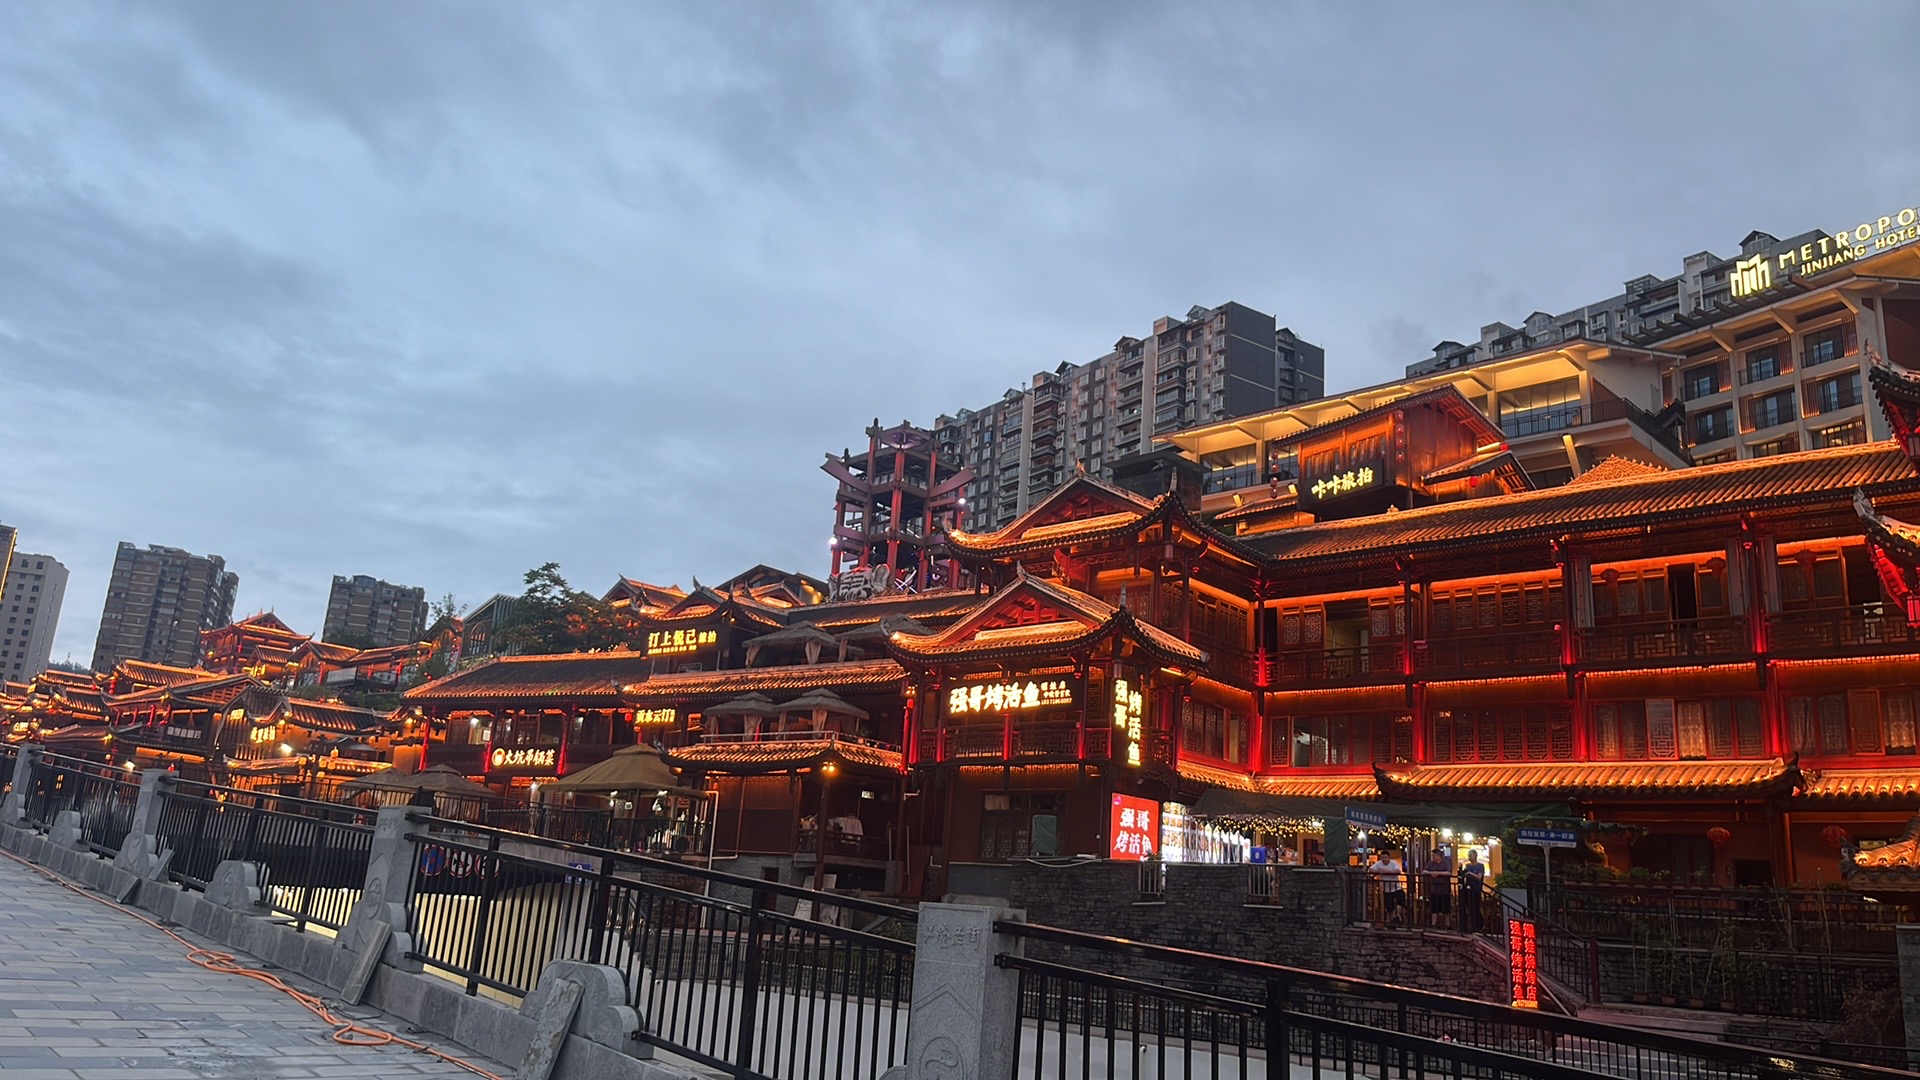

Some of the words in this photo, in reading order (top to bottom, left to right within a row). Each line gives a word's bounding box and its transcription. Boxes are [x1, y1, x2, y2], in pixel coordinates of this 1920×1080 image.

[1800, 244, 1867, 276] JINJIANG
[950, 681, 1040, 714] 强哥烤活鱼
[1114, 679, 1128, 728] 强哥
[1128, 690, 1143, 766] 烤活鱼
[1120, 807, 1150, 831] 强哥
[1113, 830, 1152, 859] 烤活鱼
[1510, 920, 1524, 998] 强哥烤活鱼
